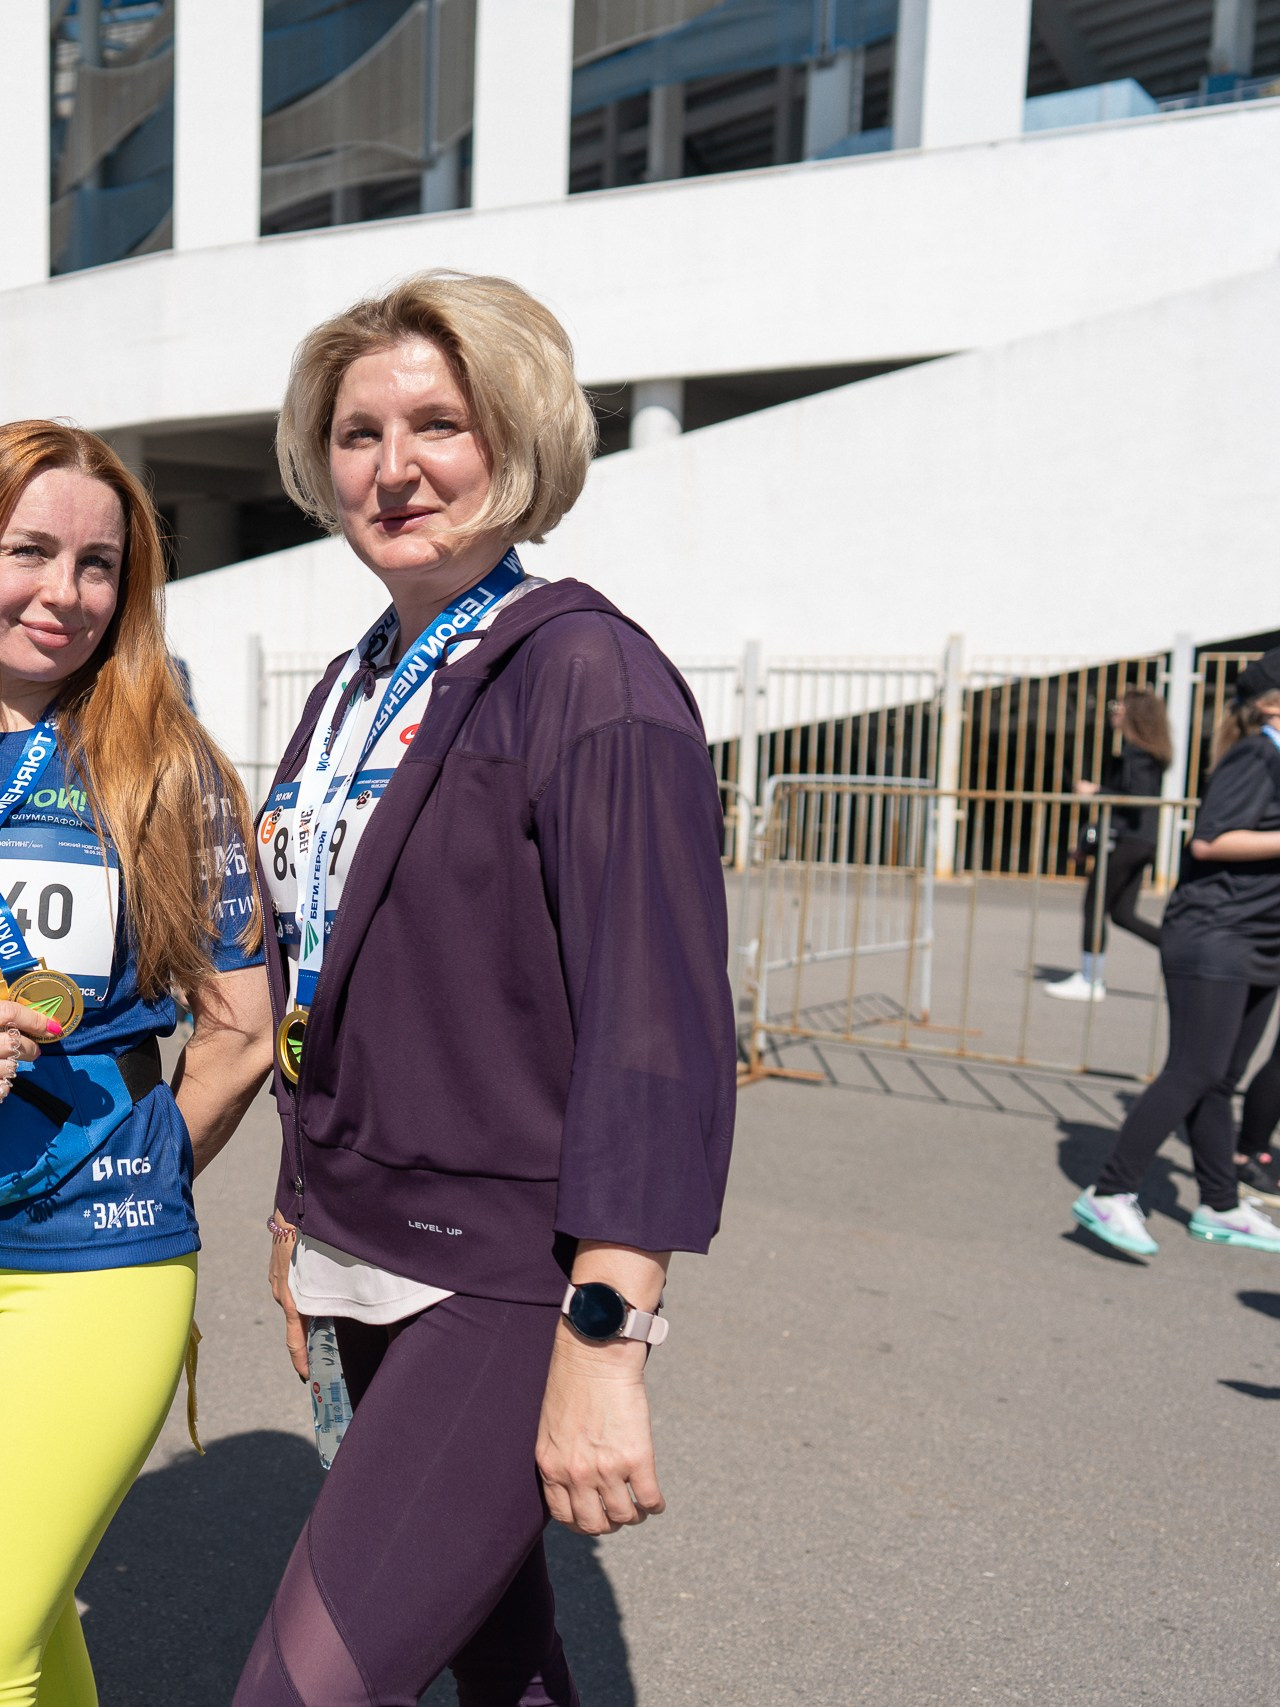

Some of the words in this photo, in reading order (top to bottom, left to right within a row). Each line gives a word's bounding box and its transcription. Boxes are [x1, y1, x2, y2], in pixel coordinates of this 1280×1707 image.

[421, 587, 495, 660] ГЕРОИ
[117, 1156, 151, 1176] ПСБ
[408, 1220, 442, 1233] LEVEL
[446, 1227, 463, 1236] UP
